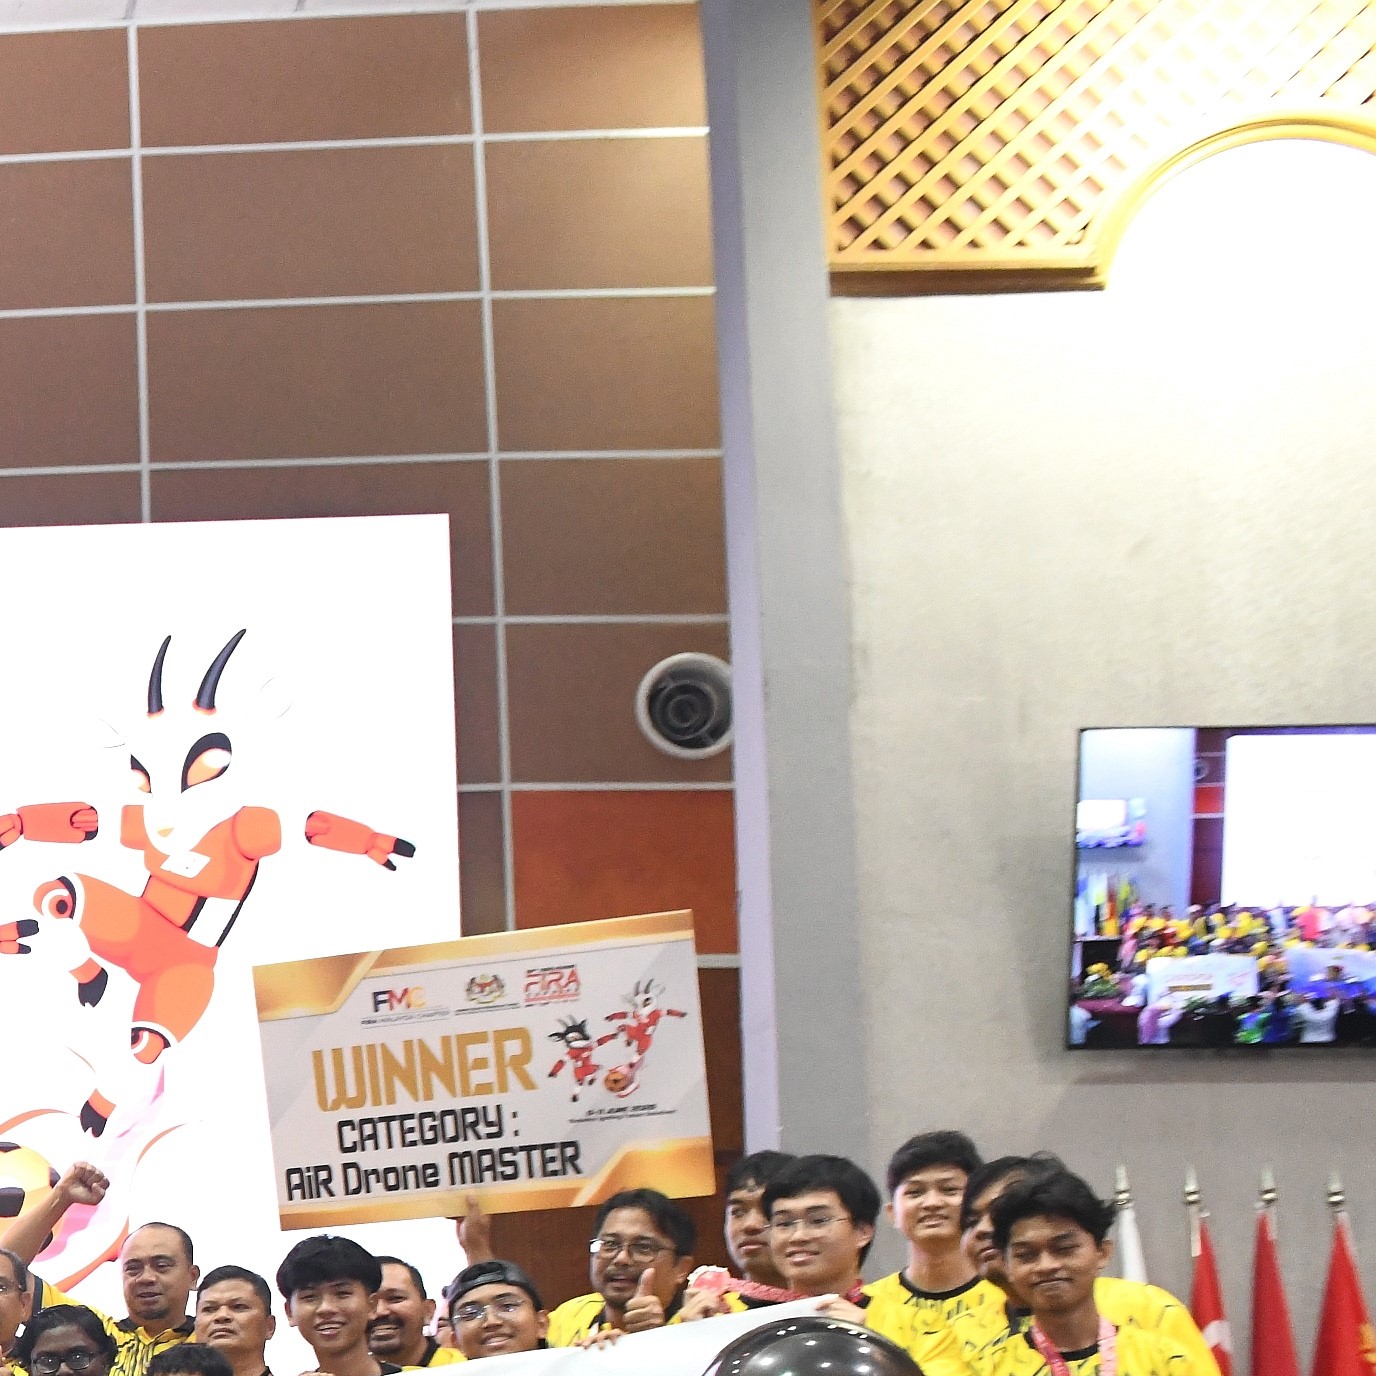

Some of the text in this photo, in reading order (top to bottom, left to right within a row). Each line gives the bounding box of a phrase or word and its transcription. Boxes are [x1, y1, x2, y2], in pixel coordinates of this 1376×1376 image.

[372, 986, 427, 1012] FMC
[312, 1027, 537, 1112] WINNER
[285, 1140, 583, 1202] AiR Drone MASTER
